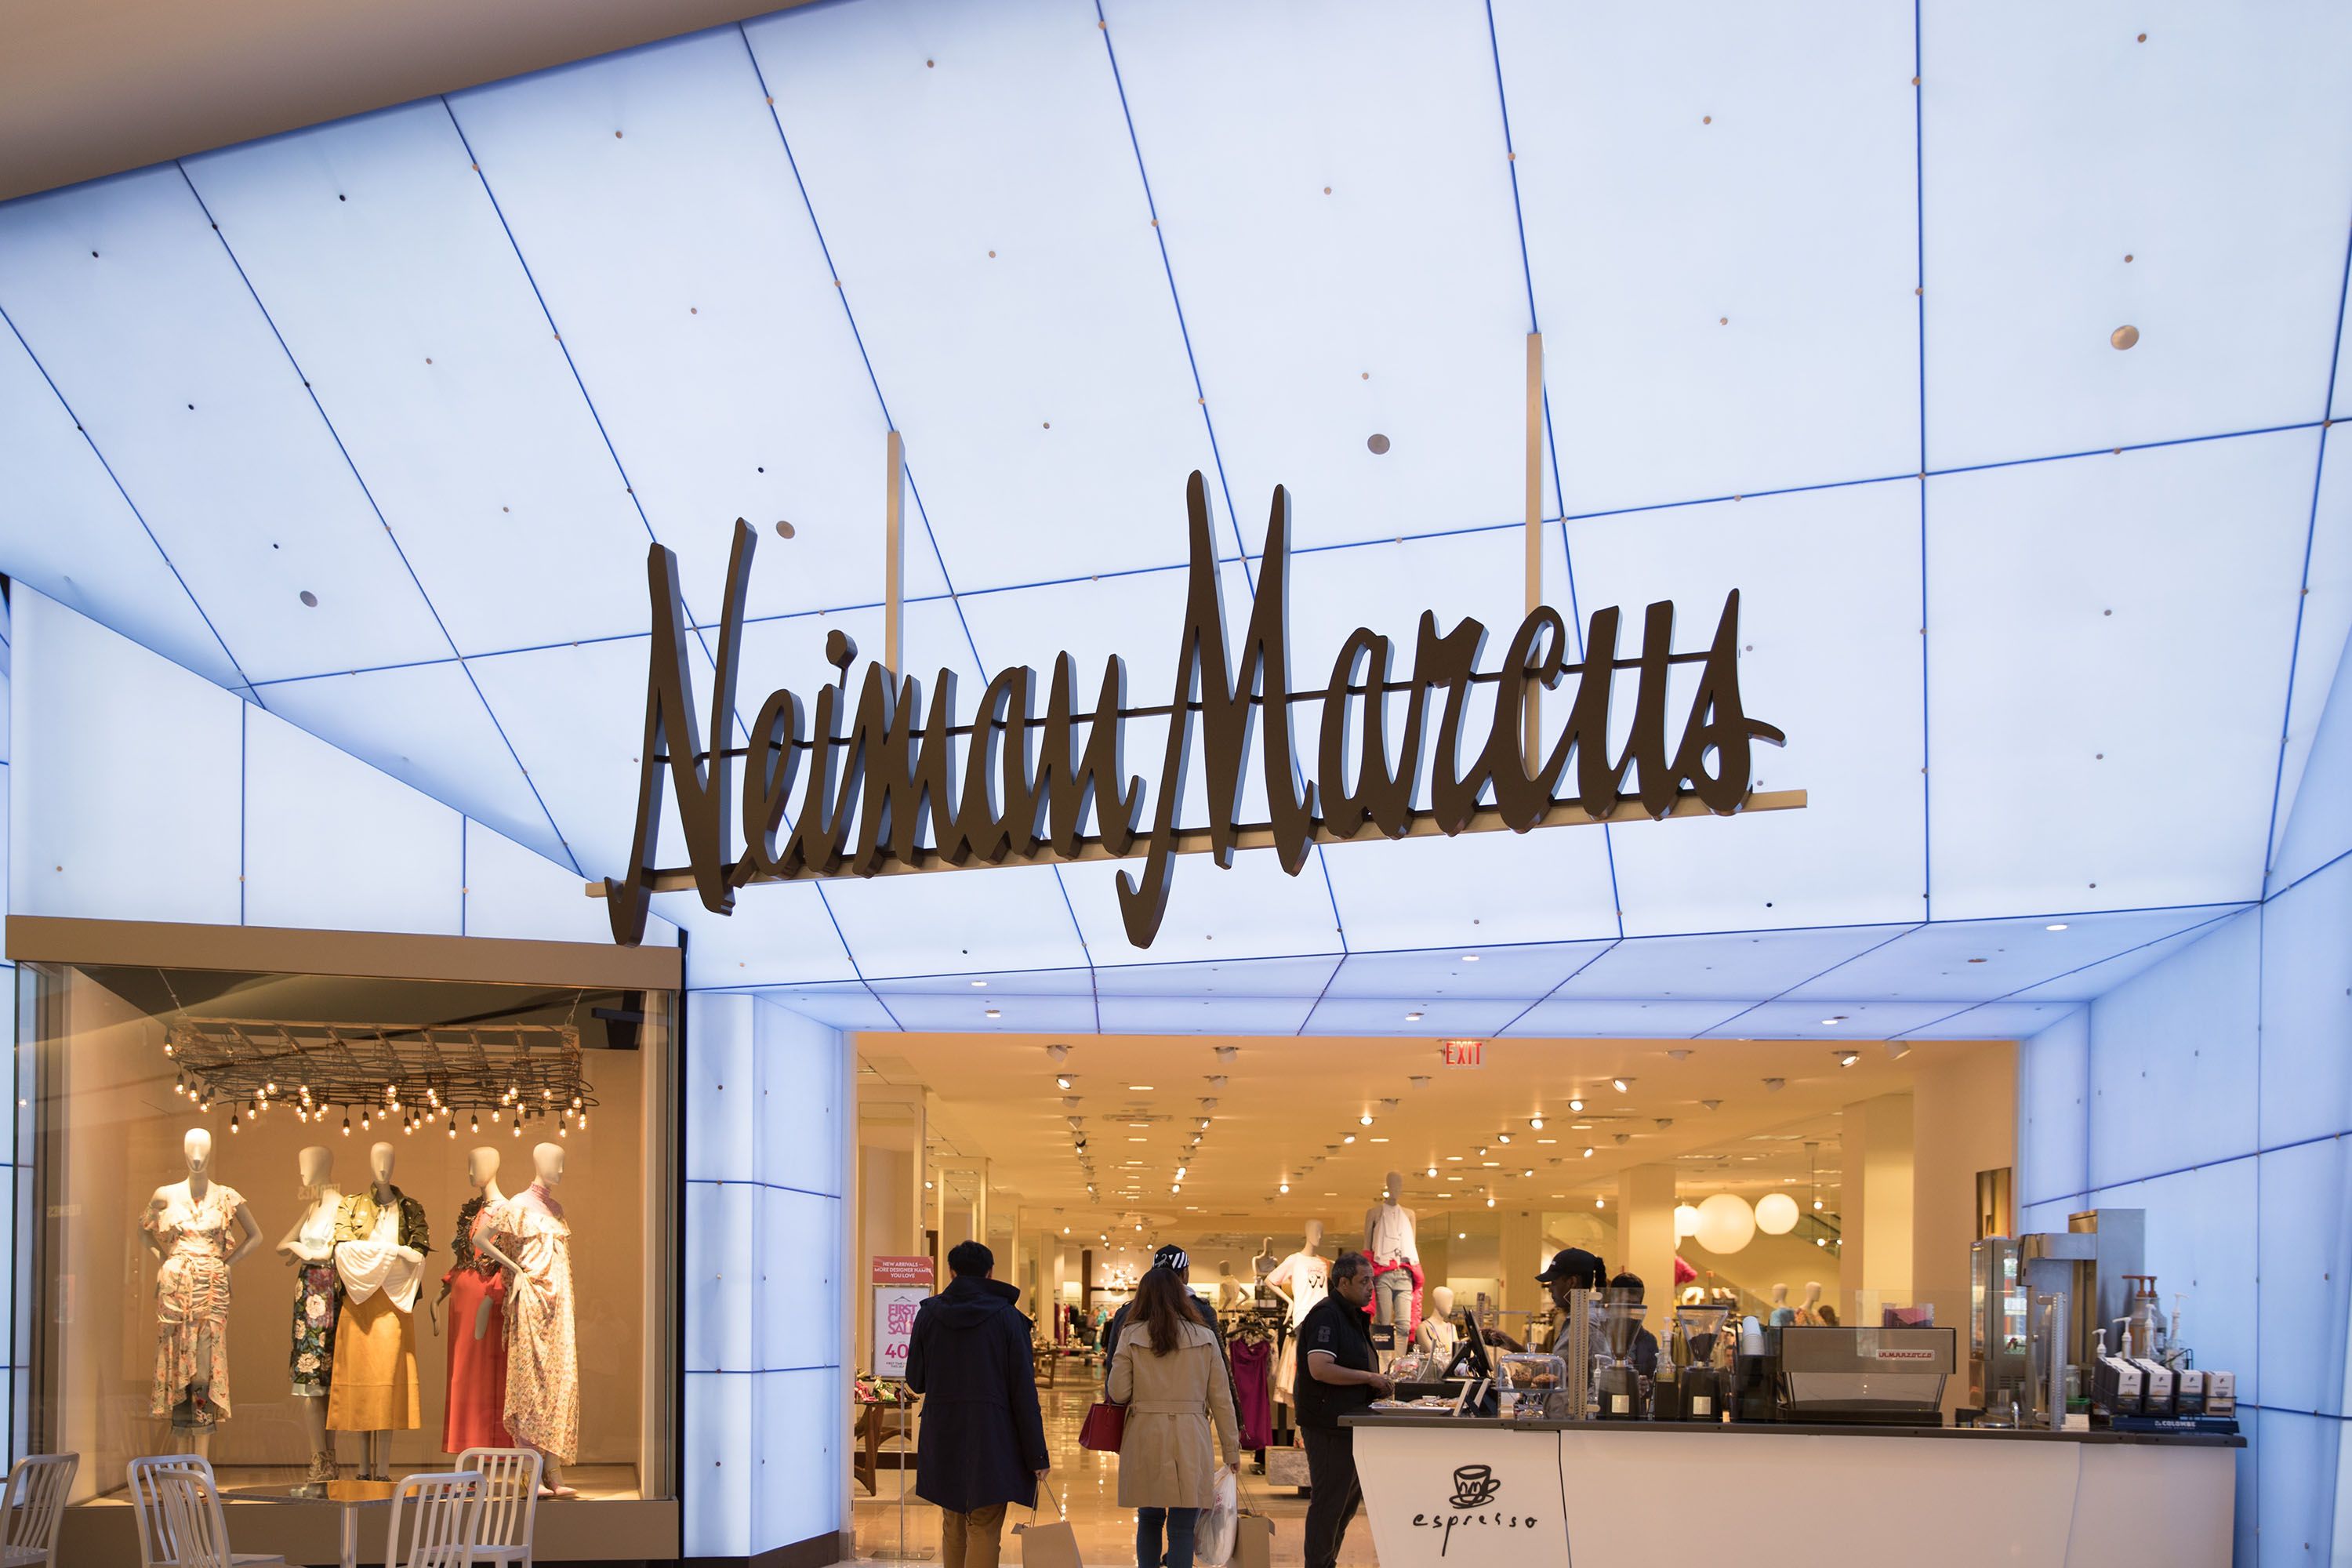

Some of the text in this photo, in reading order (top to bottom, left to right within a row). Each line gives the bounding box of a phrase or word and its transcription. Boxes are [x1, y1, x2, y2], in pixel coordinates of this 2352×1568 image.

[604, 469, 1787, 948] Neiman Marcus
[1446, 1042, 1482, 1065] EXIT
[888, 1304, 917, 1315] FIRST
[887, 1323, 913, 1334] SAL
[1413, 1512, 1537, 1557] espresso
